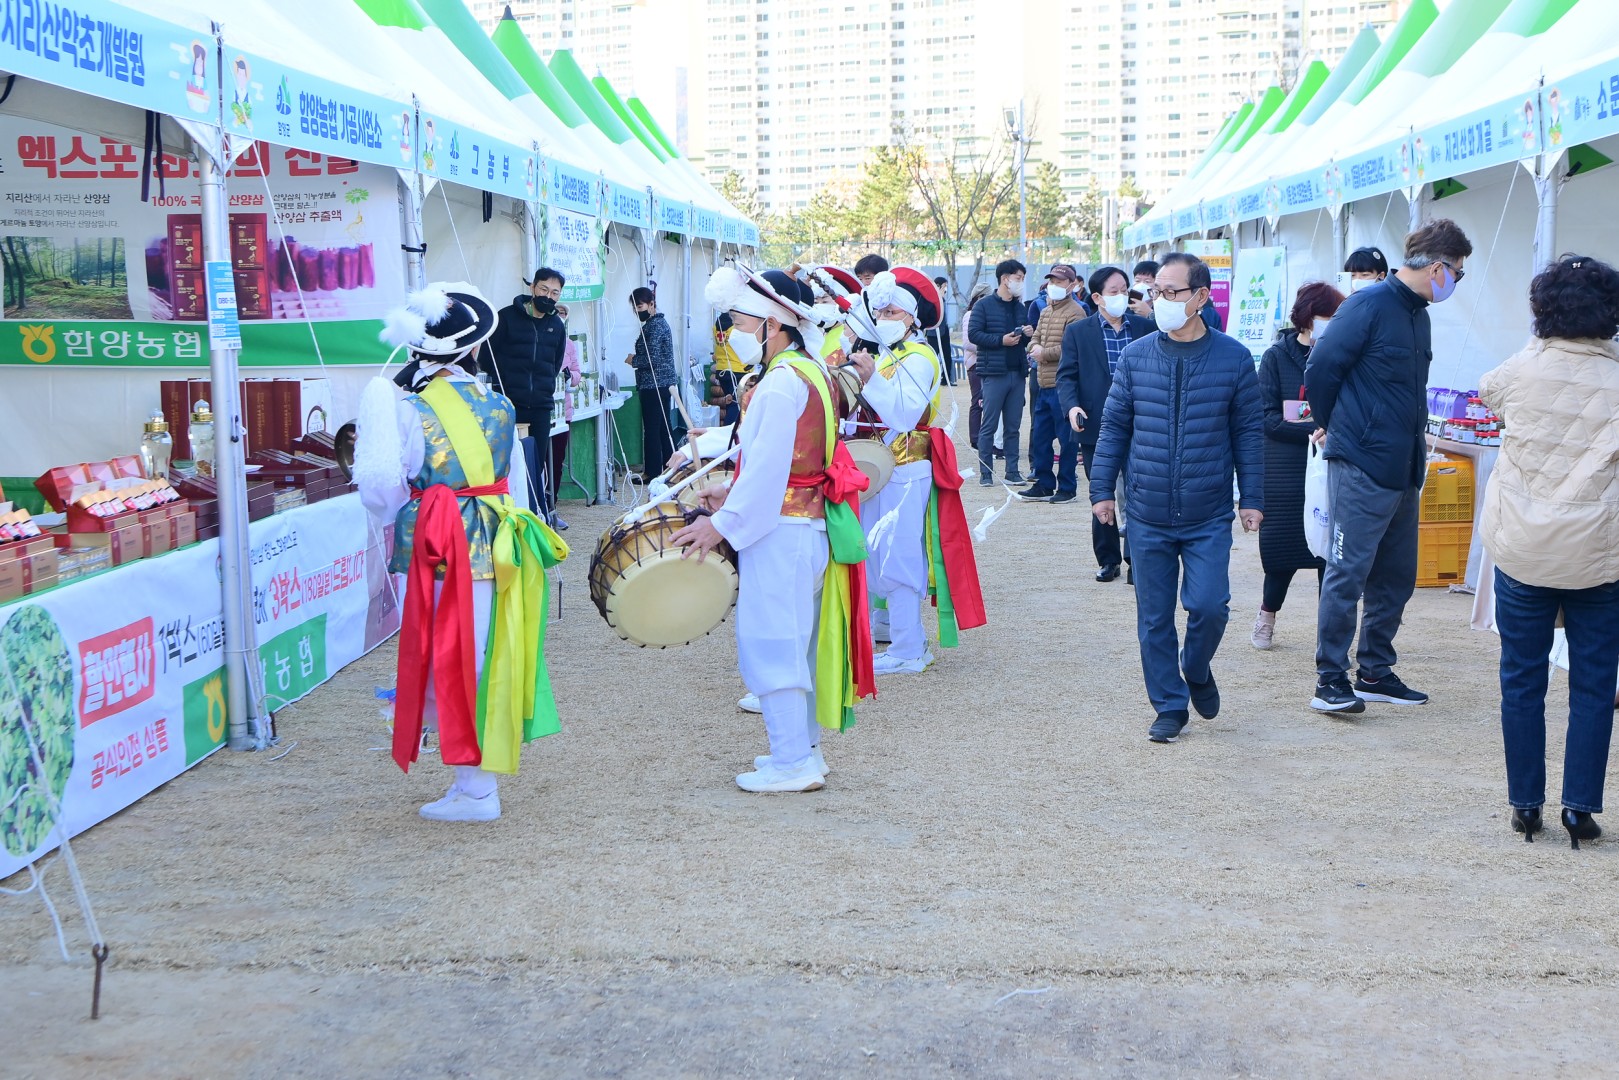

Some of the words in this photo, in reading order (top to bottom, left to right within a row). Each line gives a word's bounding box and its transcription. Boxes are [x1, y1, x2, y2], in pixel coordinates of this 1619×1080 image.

[300, 91, 338, 141] 함양농협
[340, 103, 382, 149] 가공사업소
[17, 136, 139, 178] 엑스포
[6, 193, 50, 204] 지리산에서
[54, 194, 81, 204] 자라난
[84, 194, 111, 204] 산양삼
[152, 195, 187, 207] 100%
[229, 194, 265, 206] 산양삼
[273, 211, 306, 224] 산양삼
[309, 210, 342, 222] 추출액
[62, 330, 201, 359] 함양농협
[91, 730, 144, 790] 공식인정
[144, 717, 169, 759] 상품
